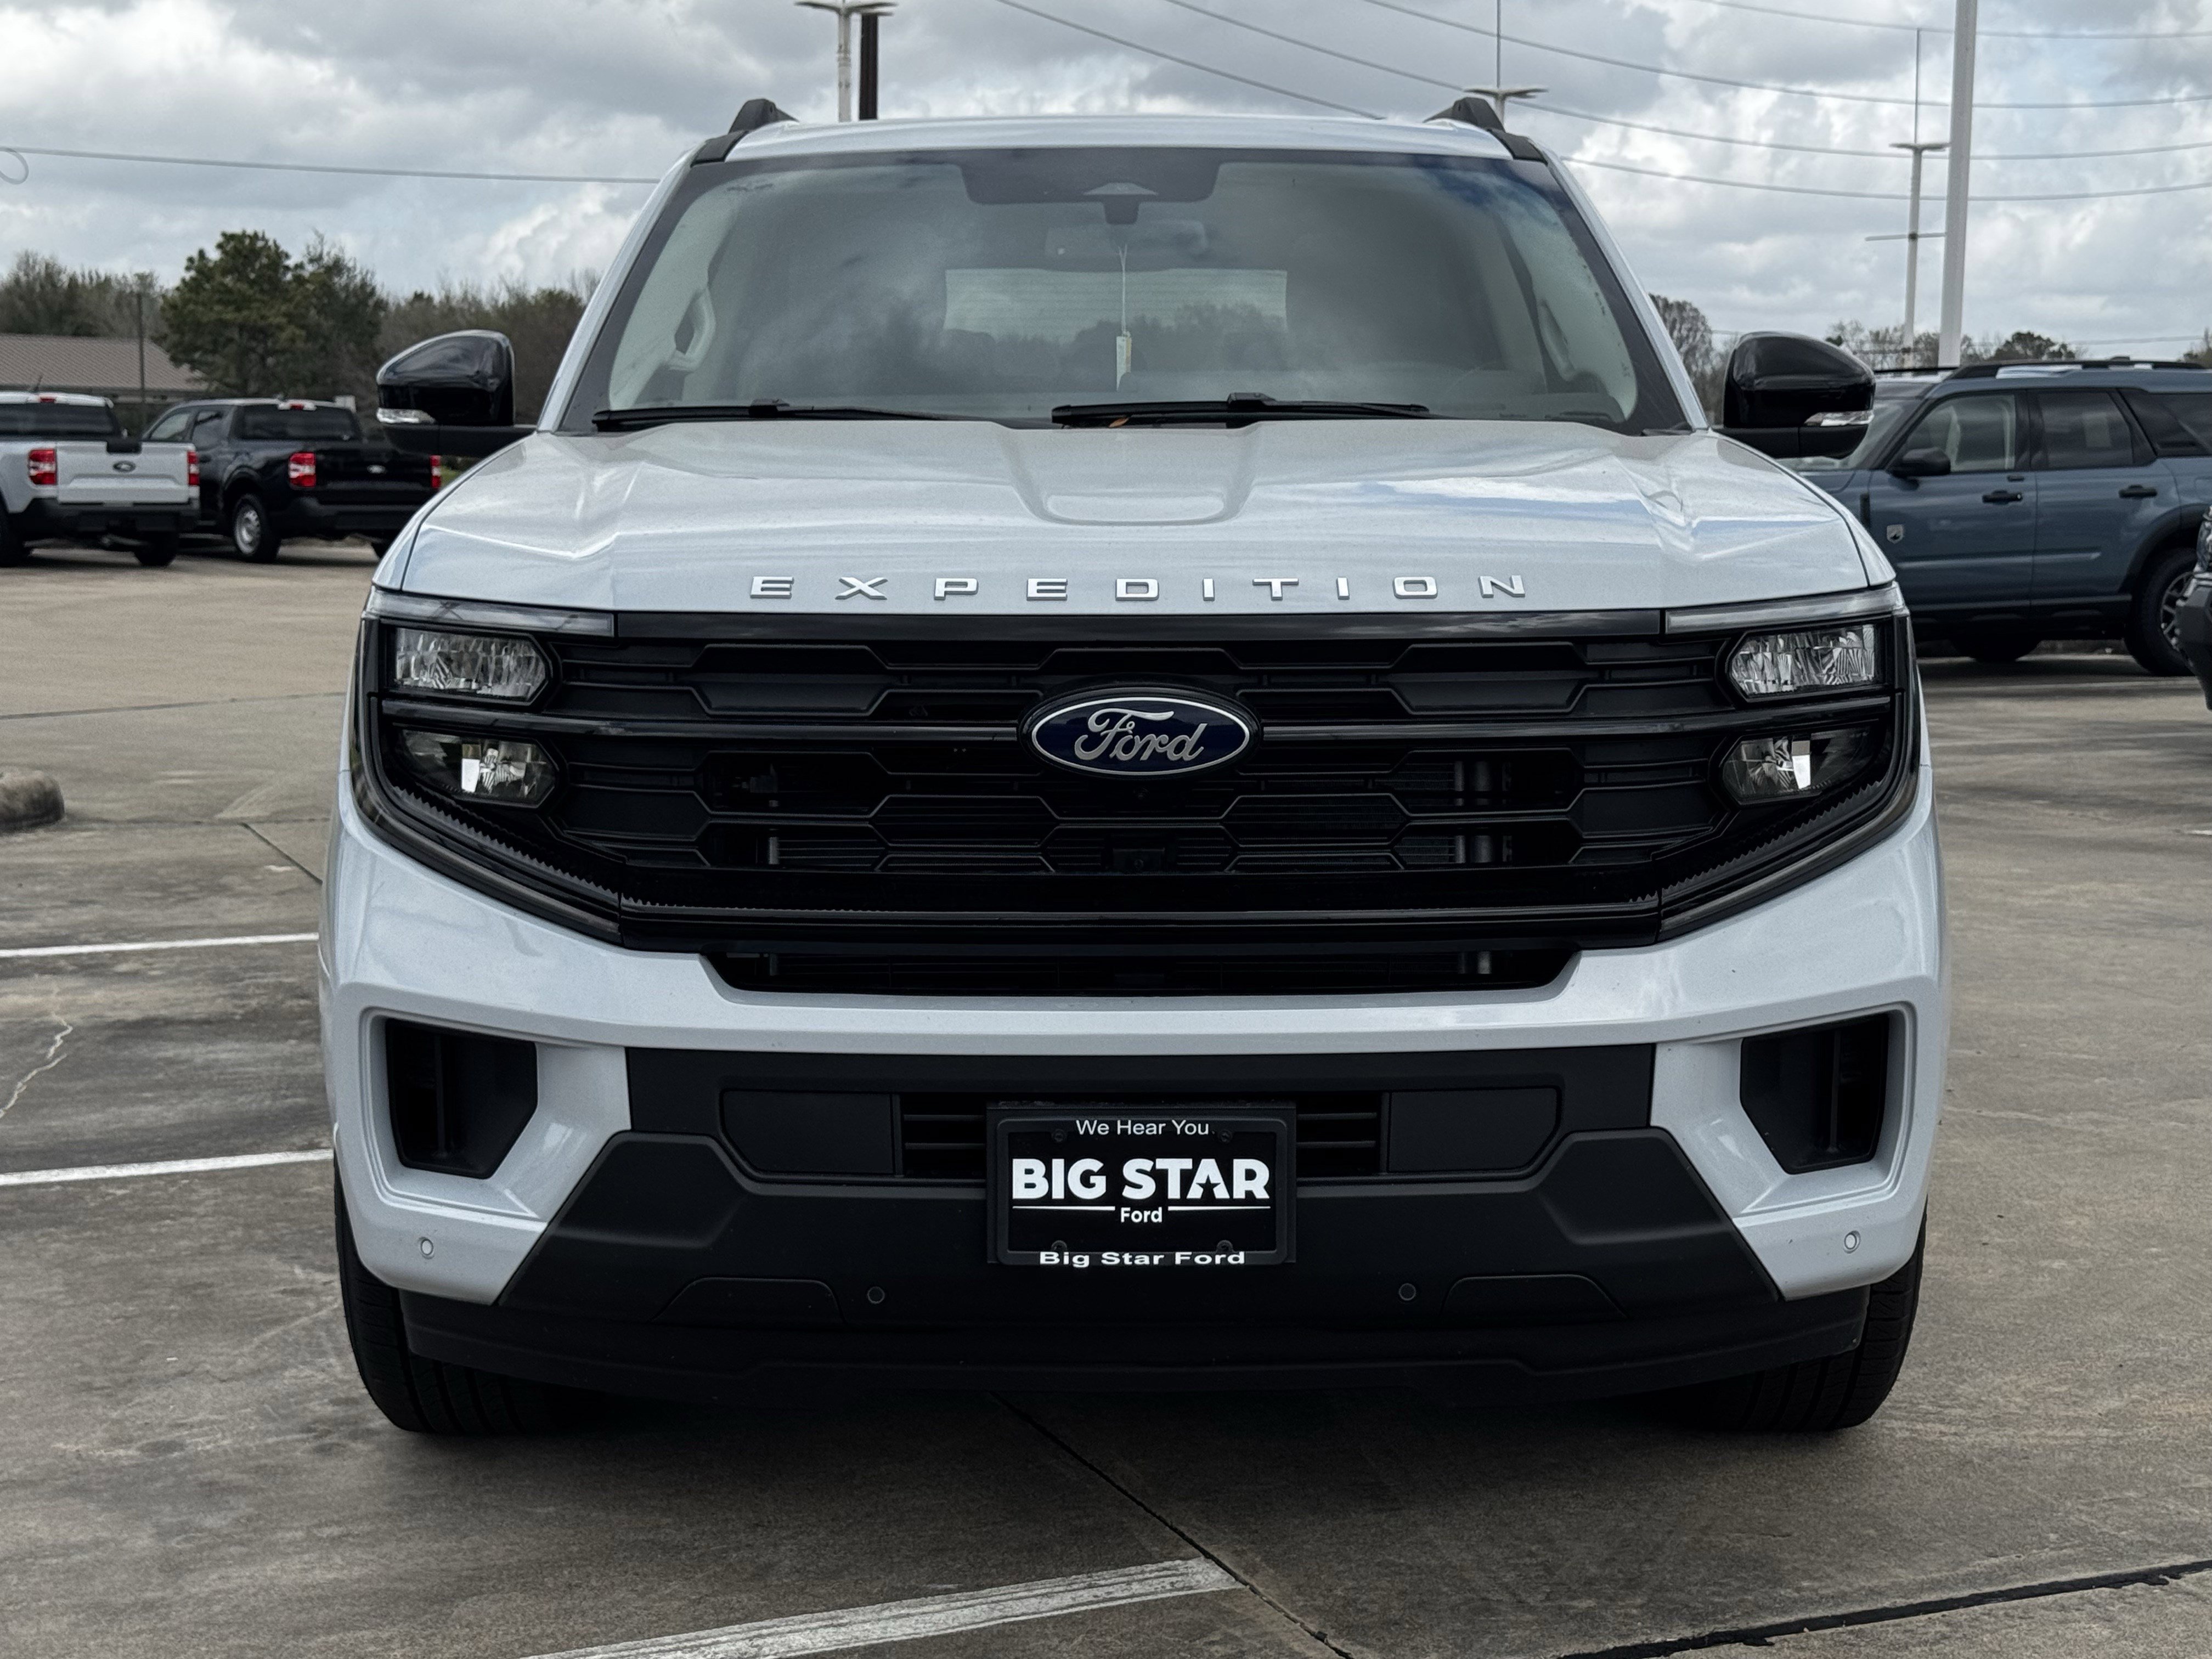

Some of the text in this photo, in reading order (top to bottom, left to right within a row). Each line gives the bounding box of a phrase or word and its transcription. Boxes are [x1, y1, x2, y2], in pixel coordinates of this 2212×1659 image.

[749, 575, 1526, 601] EXPEDITION
[1074, 708, 1207, 761] Ford
[1076, 1119, 1209, 1135] We Hear You
[1012, 1158, 1270, 1200] BIG STAR
[1120, 1207, 1163, 1223] Ford
[1040, 1251, 1245, 1268] Big Star Ford
